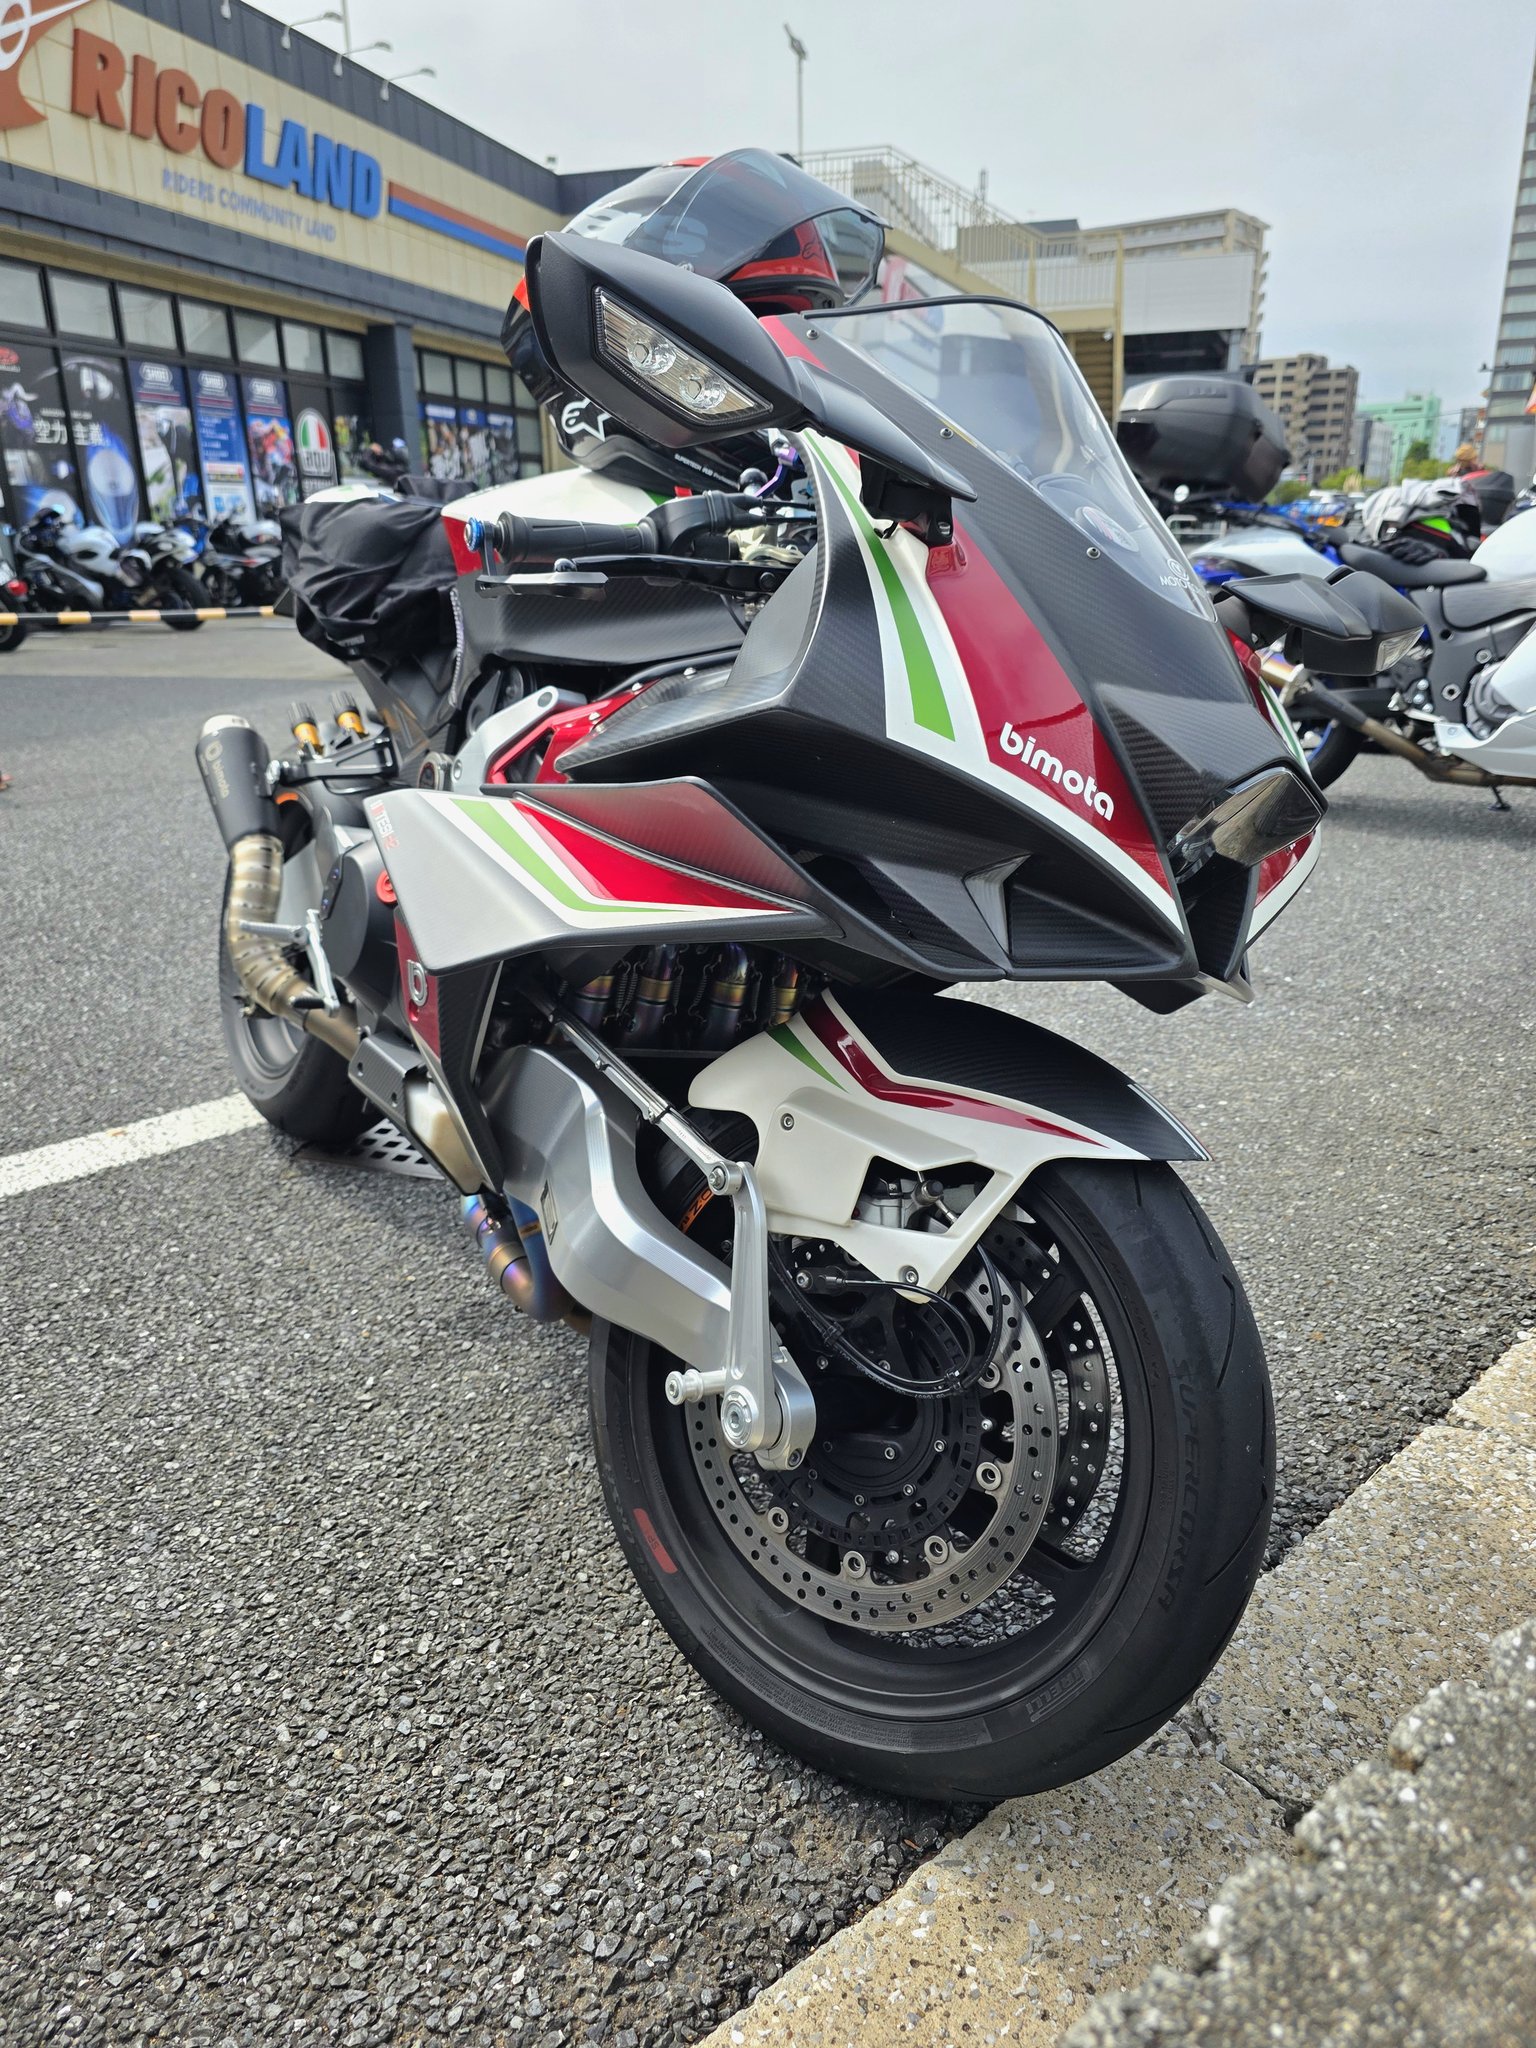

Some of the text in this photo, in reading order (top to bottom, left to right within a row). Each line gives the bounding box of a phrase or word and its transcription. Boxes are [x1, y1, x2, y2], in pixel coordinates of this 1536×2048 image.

[71, 28, 381, 220] RICOLAND
[162, 168, 337, 243] RIDERS COMMUNITY LAND
[211, 761, 231, 799] bimota
[999, 722, 1115, 821] bimota
[1157, 1357, 1201, 1613] SUPERCORSA
[1025, 1659, 1096, 1723] PIRELLI
